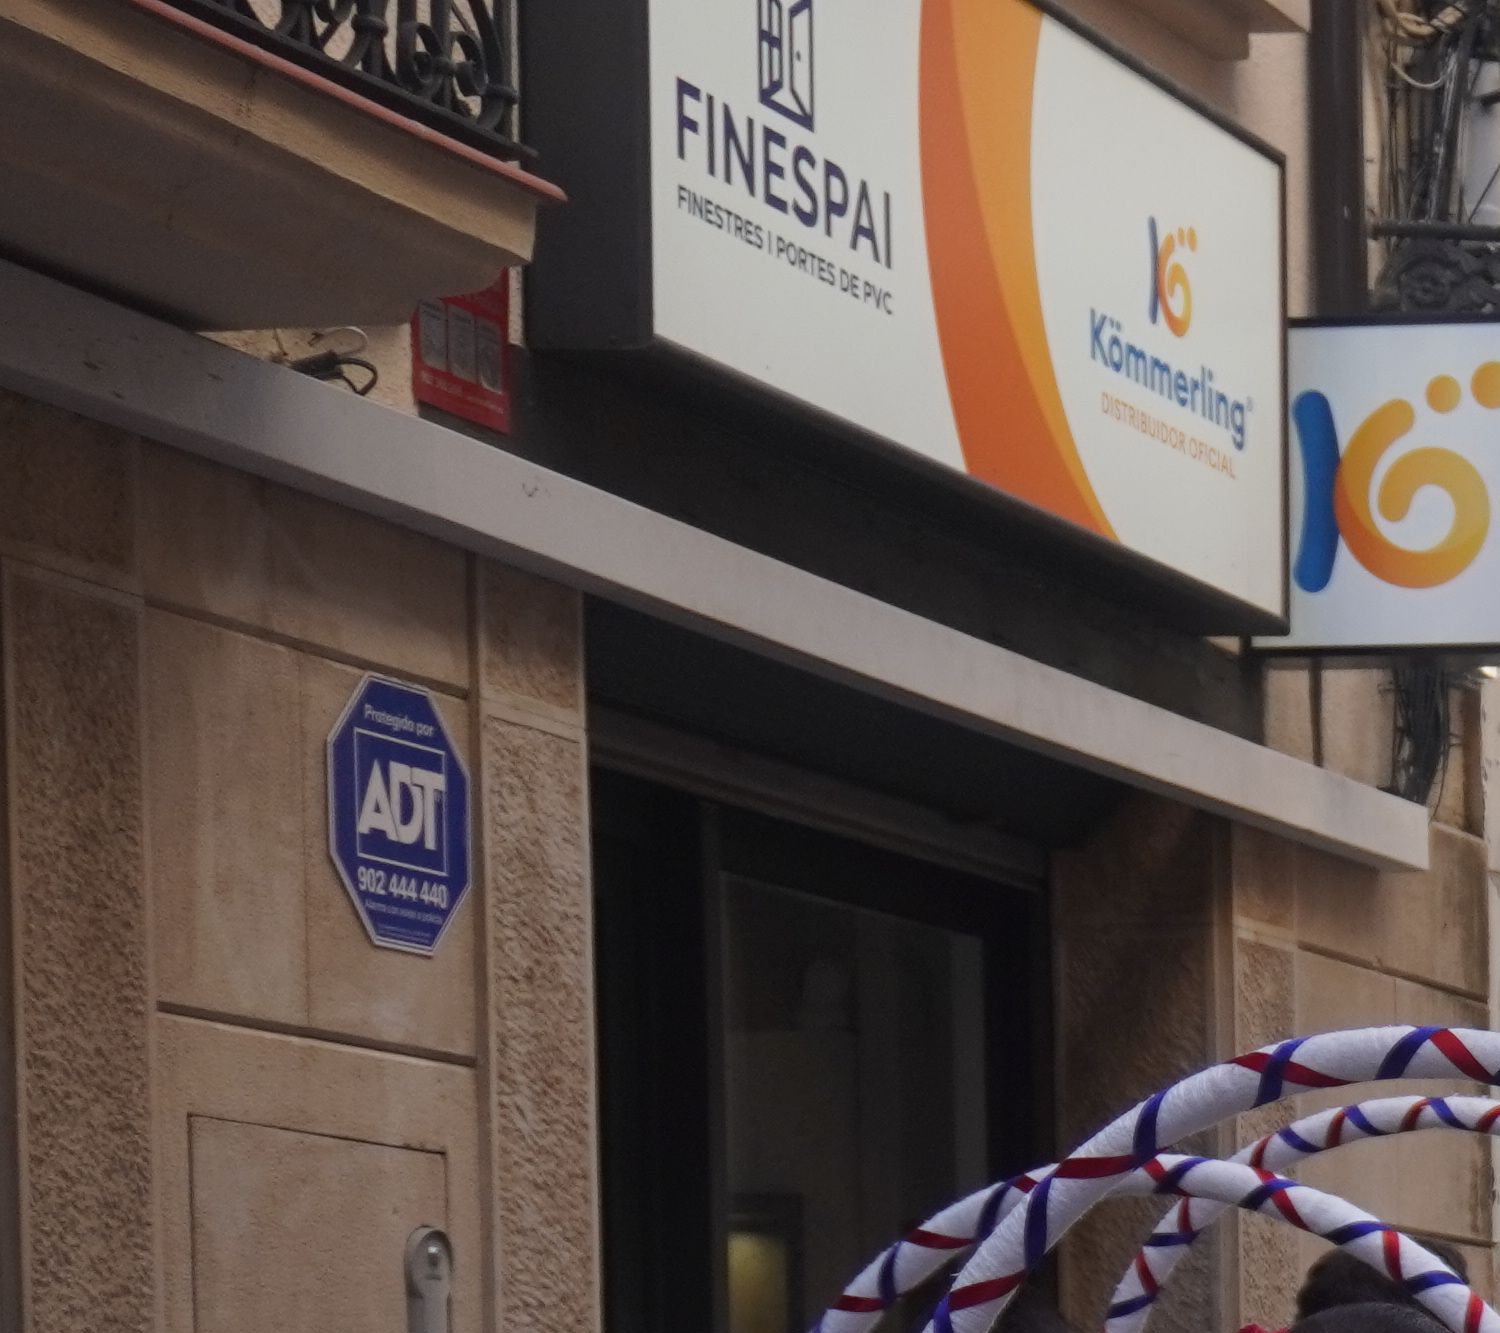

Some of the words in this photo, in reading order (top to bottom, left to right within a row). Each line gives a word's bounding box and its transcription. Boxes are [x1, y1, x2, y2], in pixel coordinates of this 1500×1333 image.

[676, 76, 892, 269] FINESPAI
[677, 184, 763, 250] FINESTRES
[767, 230, 772, 255] I
[776, 235, 836, 287] PORTES
[840, 268, 860, 300] DE
[863, 281, 893, 316] PVC
[1101, 390, 1186, 456] DISTRIBUIDOR
[1189, 438, 1237, 480] OFICIAL
[363, 703, 415, 734] Protegido
[415, 721, 434, 738] por
[358, 758, 446, 850] ADT
[357, 865, 387, 895] 902
[388, 873, 418, 903] 444
[420, 879, 449, 911] 440
